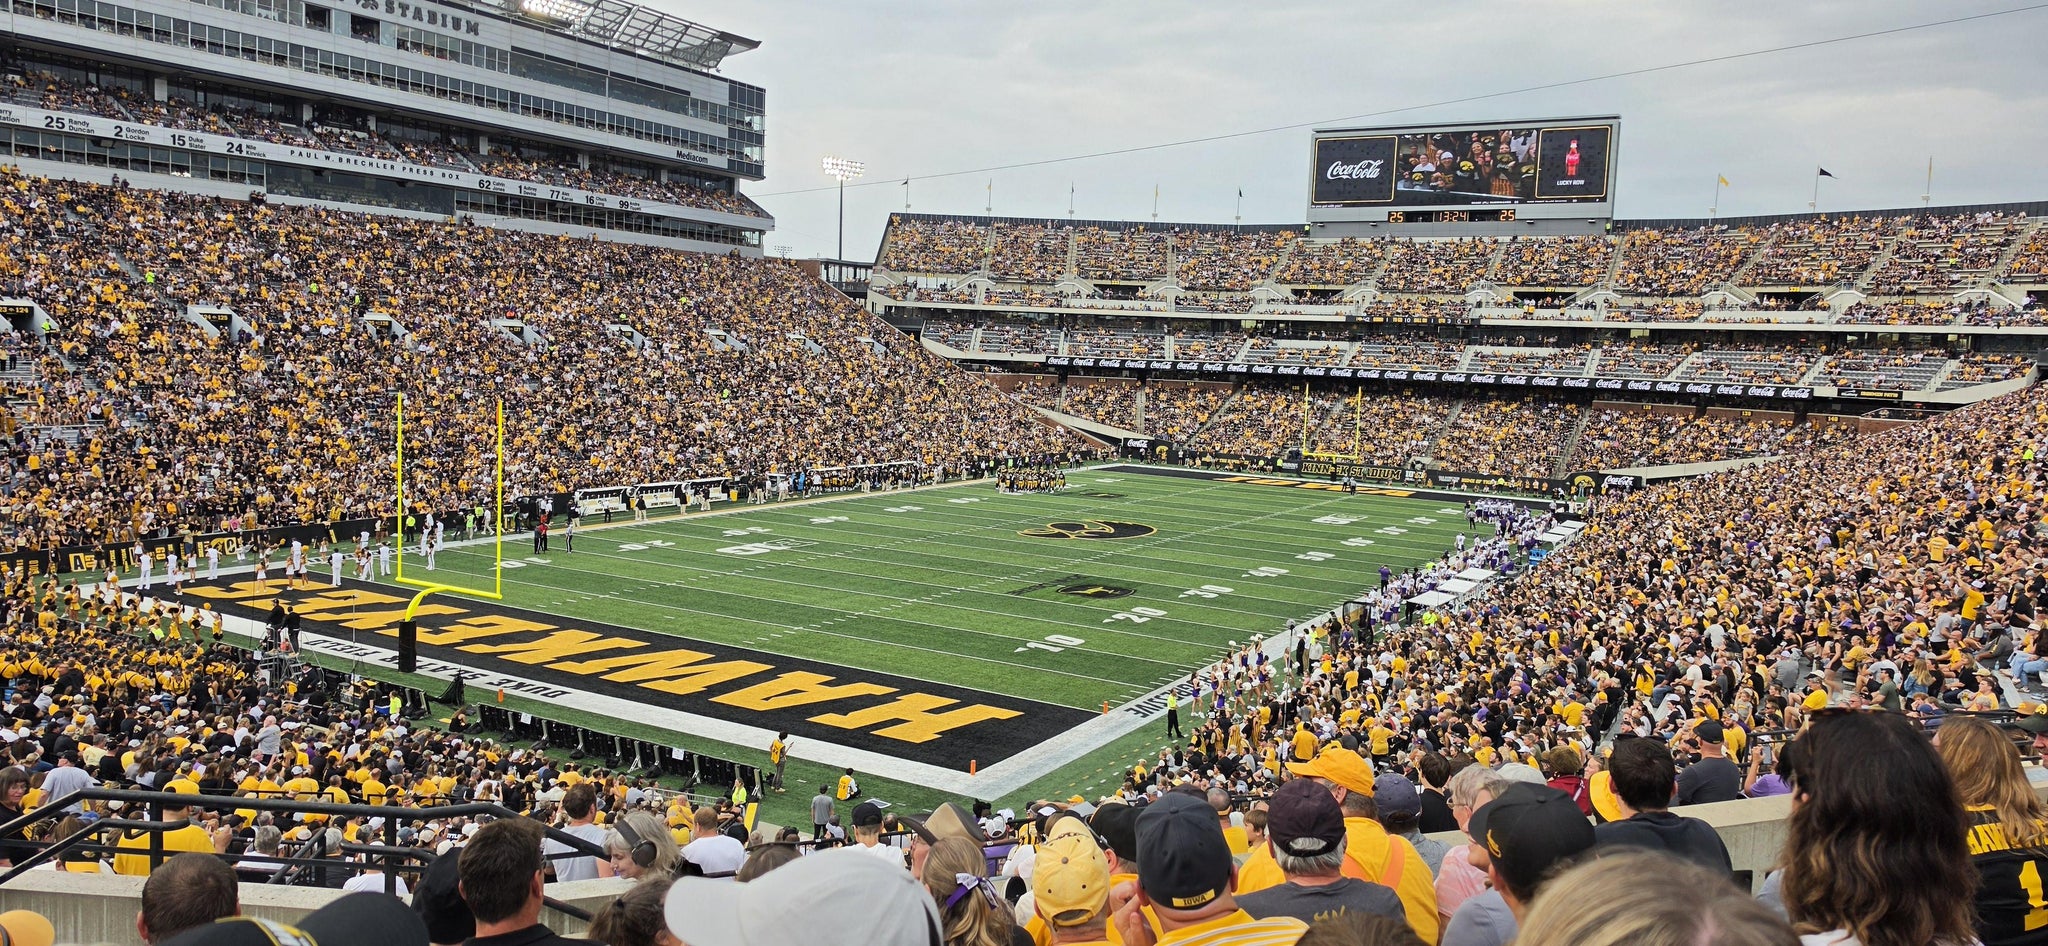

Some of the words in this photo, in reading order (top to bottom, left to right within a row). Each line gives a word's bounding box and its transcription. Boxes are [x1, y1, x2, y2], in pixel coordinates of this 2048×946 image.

[385, 2, 480, 36] STADIUM
[0, 115, 20, 123] tation
[44, 115, 66, 130] 25
[68, 118, 90, 128] Randy
[68, 126, 95, 134] Duncan
[113, 125, 124, 138] 2
[125, 126, 150, 136] Gordon
[125, 133, 146, 142] Locke
[170, 133, 186, 147] 15
[226, 142, 244, 155] 24
[676, 149, 709, 164] Mediacom
[290, 149, 319, 160] PAUL
[338, 156, 395, 171] BRECHLER
[402, 166, 434, 177] PRESS
[441, 172, 460, 180] BOX
[1327, 158, 1384, 180] Coca-Cola
[478, 179, 491, 190] 62
[549, 189, 561, 199] 77
[585, 195, 595, 204] 16
[619, 200, 629, 210] 99
[1390, 211, 1404, 223] 25
[1438, 211, 1467, 222] 13:24
[1500, 210, 1515, 221] 25
[1184, 584, 1235, 599] 30
[1111, 606, 1169, 624] 20
[304, 638, 383, 658] FIELD
[1026, 634, 1086, 653] 10
[181, 578, 1026, 744] HAWKEYES
[380, 655, 490, 681] SLATR
[486, 678, 573, 699] DUKE
[1183, 893, 1207, 906] IOWA
